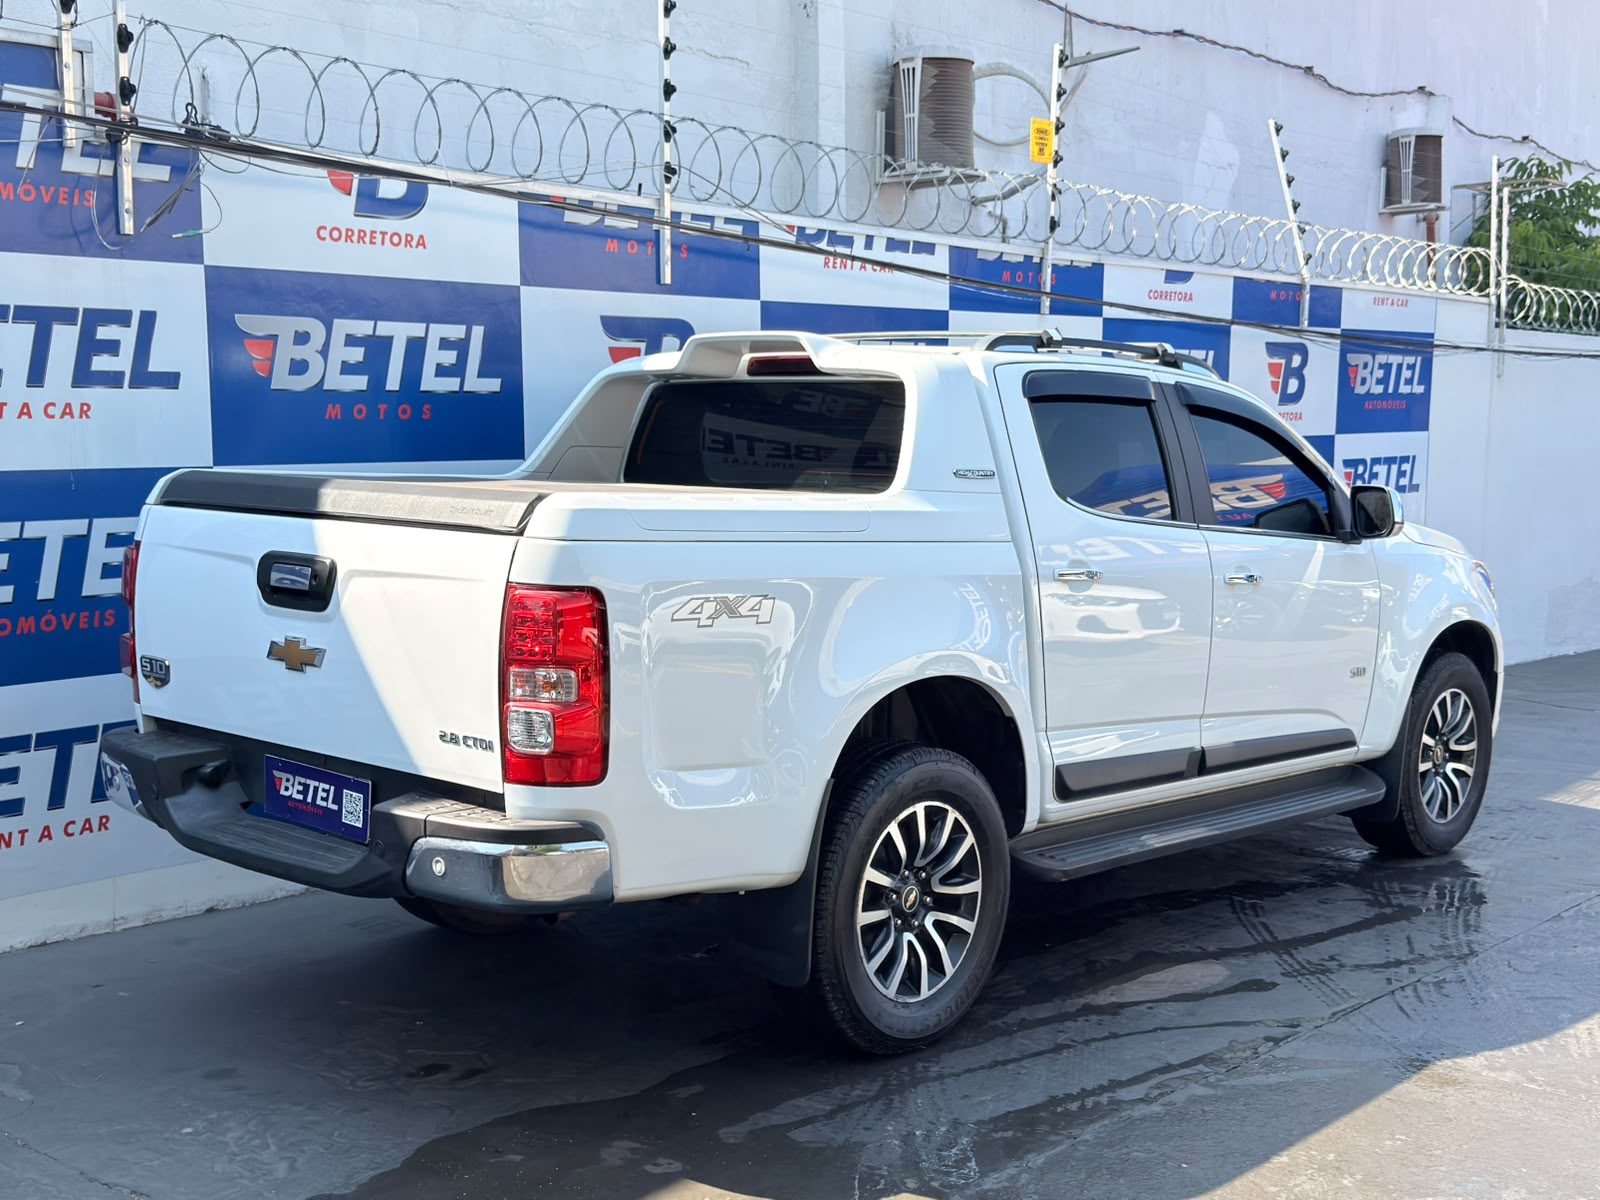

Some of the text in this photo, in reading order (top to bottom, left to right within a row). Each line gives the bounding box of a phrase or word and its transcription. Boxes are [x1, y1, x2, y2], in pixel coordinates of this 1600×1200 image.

[316, 225, 427, 250] CORRETORA
[606, 239, 688, 259] MOTS
[1148, 289, 1193, 303] CORRETORA
[1270, 290, 1303, 302] MOTO
[1373, 297, 1389, 307] RENT
[1396, 298, 1409, 308] CAR
[234, 314, 502, 393] BETEL
[1346, 353, 1425, 395] BETEL
[17, 402, 32, 419] A
[43, 402, 91, 419] CAR
[325, 404, 432, 420] MOTOS
[1342, 455, 1420, 494] BETEL
[272, 770, 338, 811] BETEL
[38, 824, 53, 843] A
[63, 815, 110, 837] CAR
